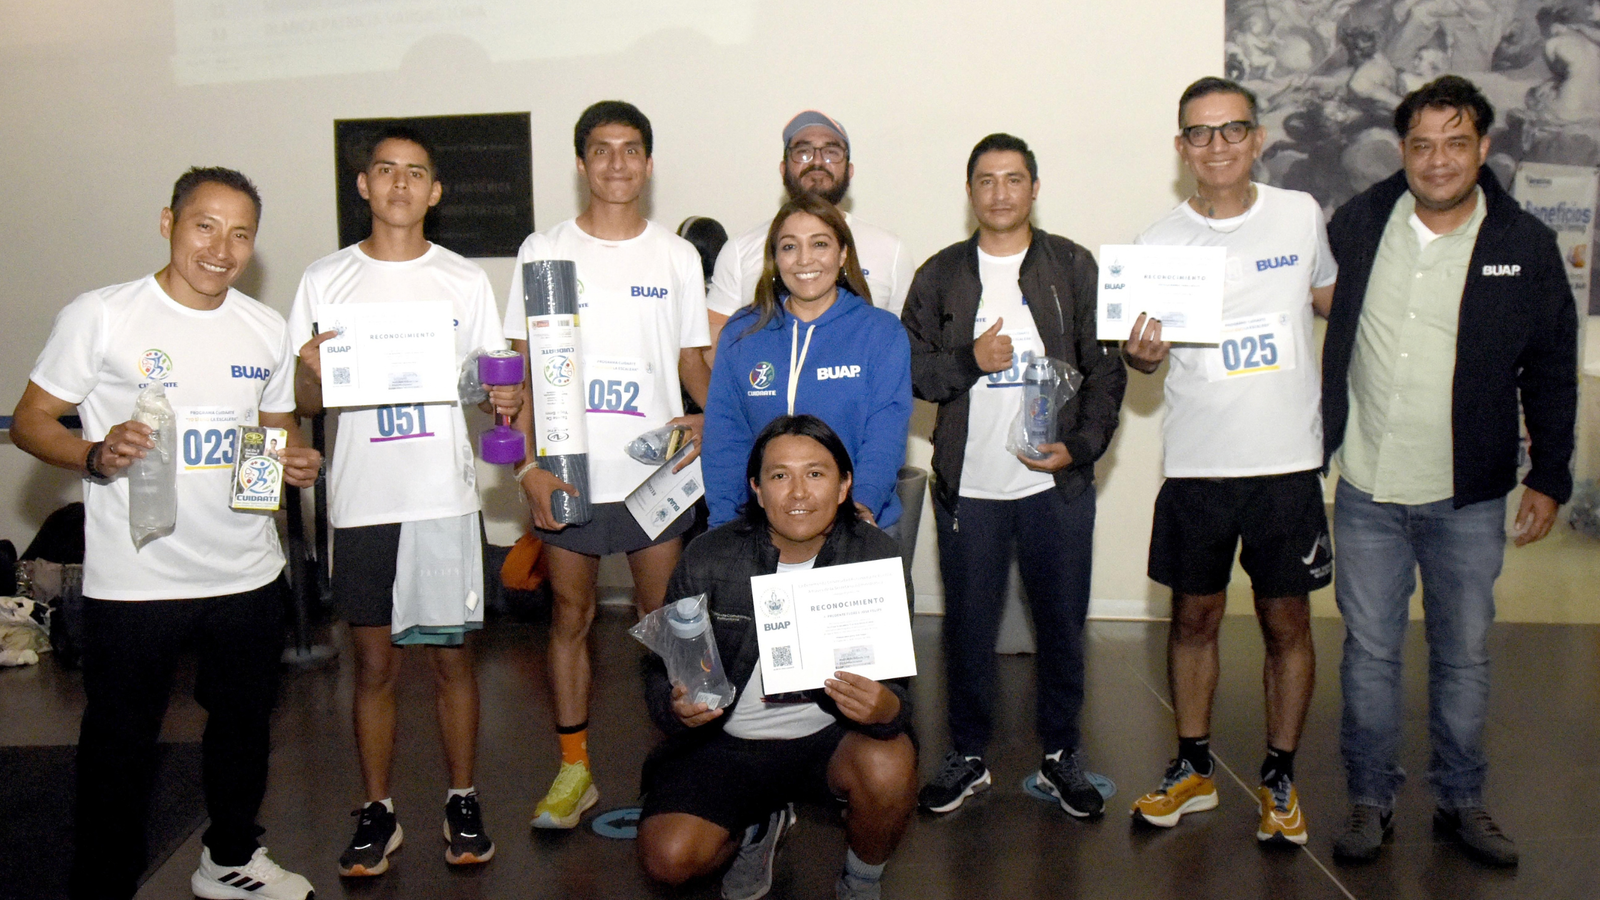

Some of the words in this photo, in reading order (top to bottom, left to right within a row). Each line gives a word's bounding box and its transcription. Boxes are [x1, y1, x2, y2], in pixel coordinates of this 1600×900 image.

[1256, 254, 1298, 272] BUAP
[1482, 264, 1521, 276] BUAP
[631, 286, 668, 299] BUAP
[369, 331, 435, 340] RECONOCIMIENTO
[327, 345, 351, 354] BUAP
[1222, 333, 1278, 371] 025
[231, 365, 270, 381] BUAP
[817, 365, 862, 381] BUAP
[588, 379, 640, 412] 052
[377, 403, 427, 437] 051
[183, 428, 237, 466] 023
[667, 497, 681, 512] BUAP
[810, 597, 885, 612] RECONOCIMIENTO
[764, 620, 791, 632] BUAP
